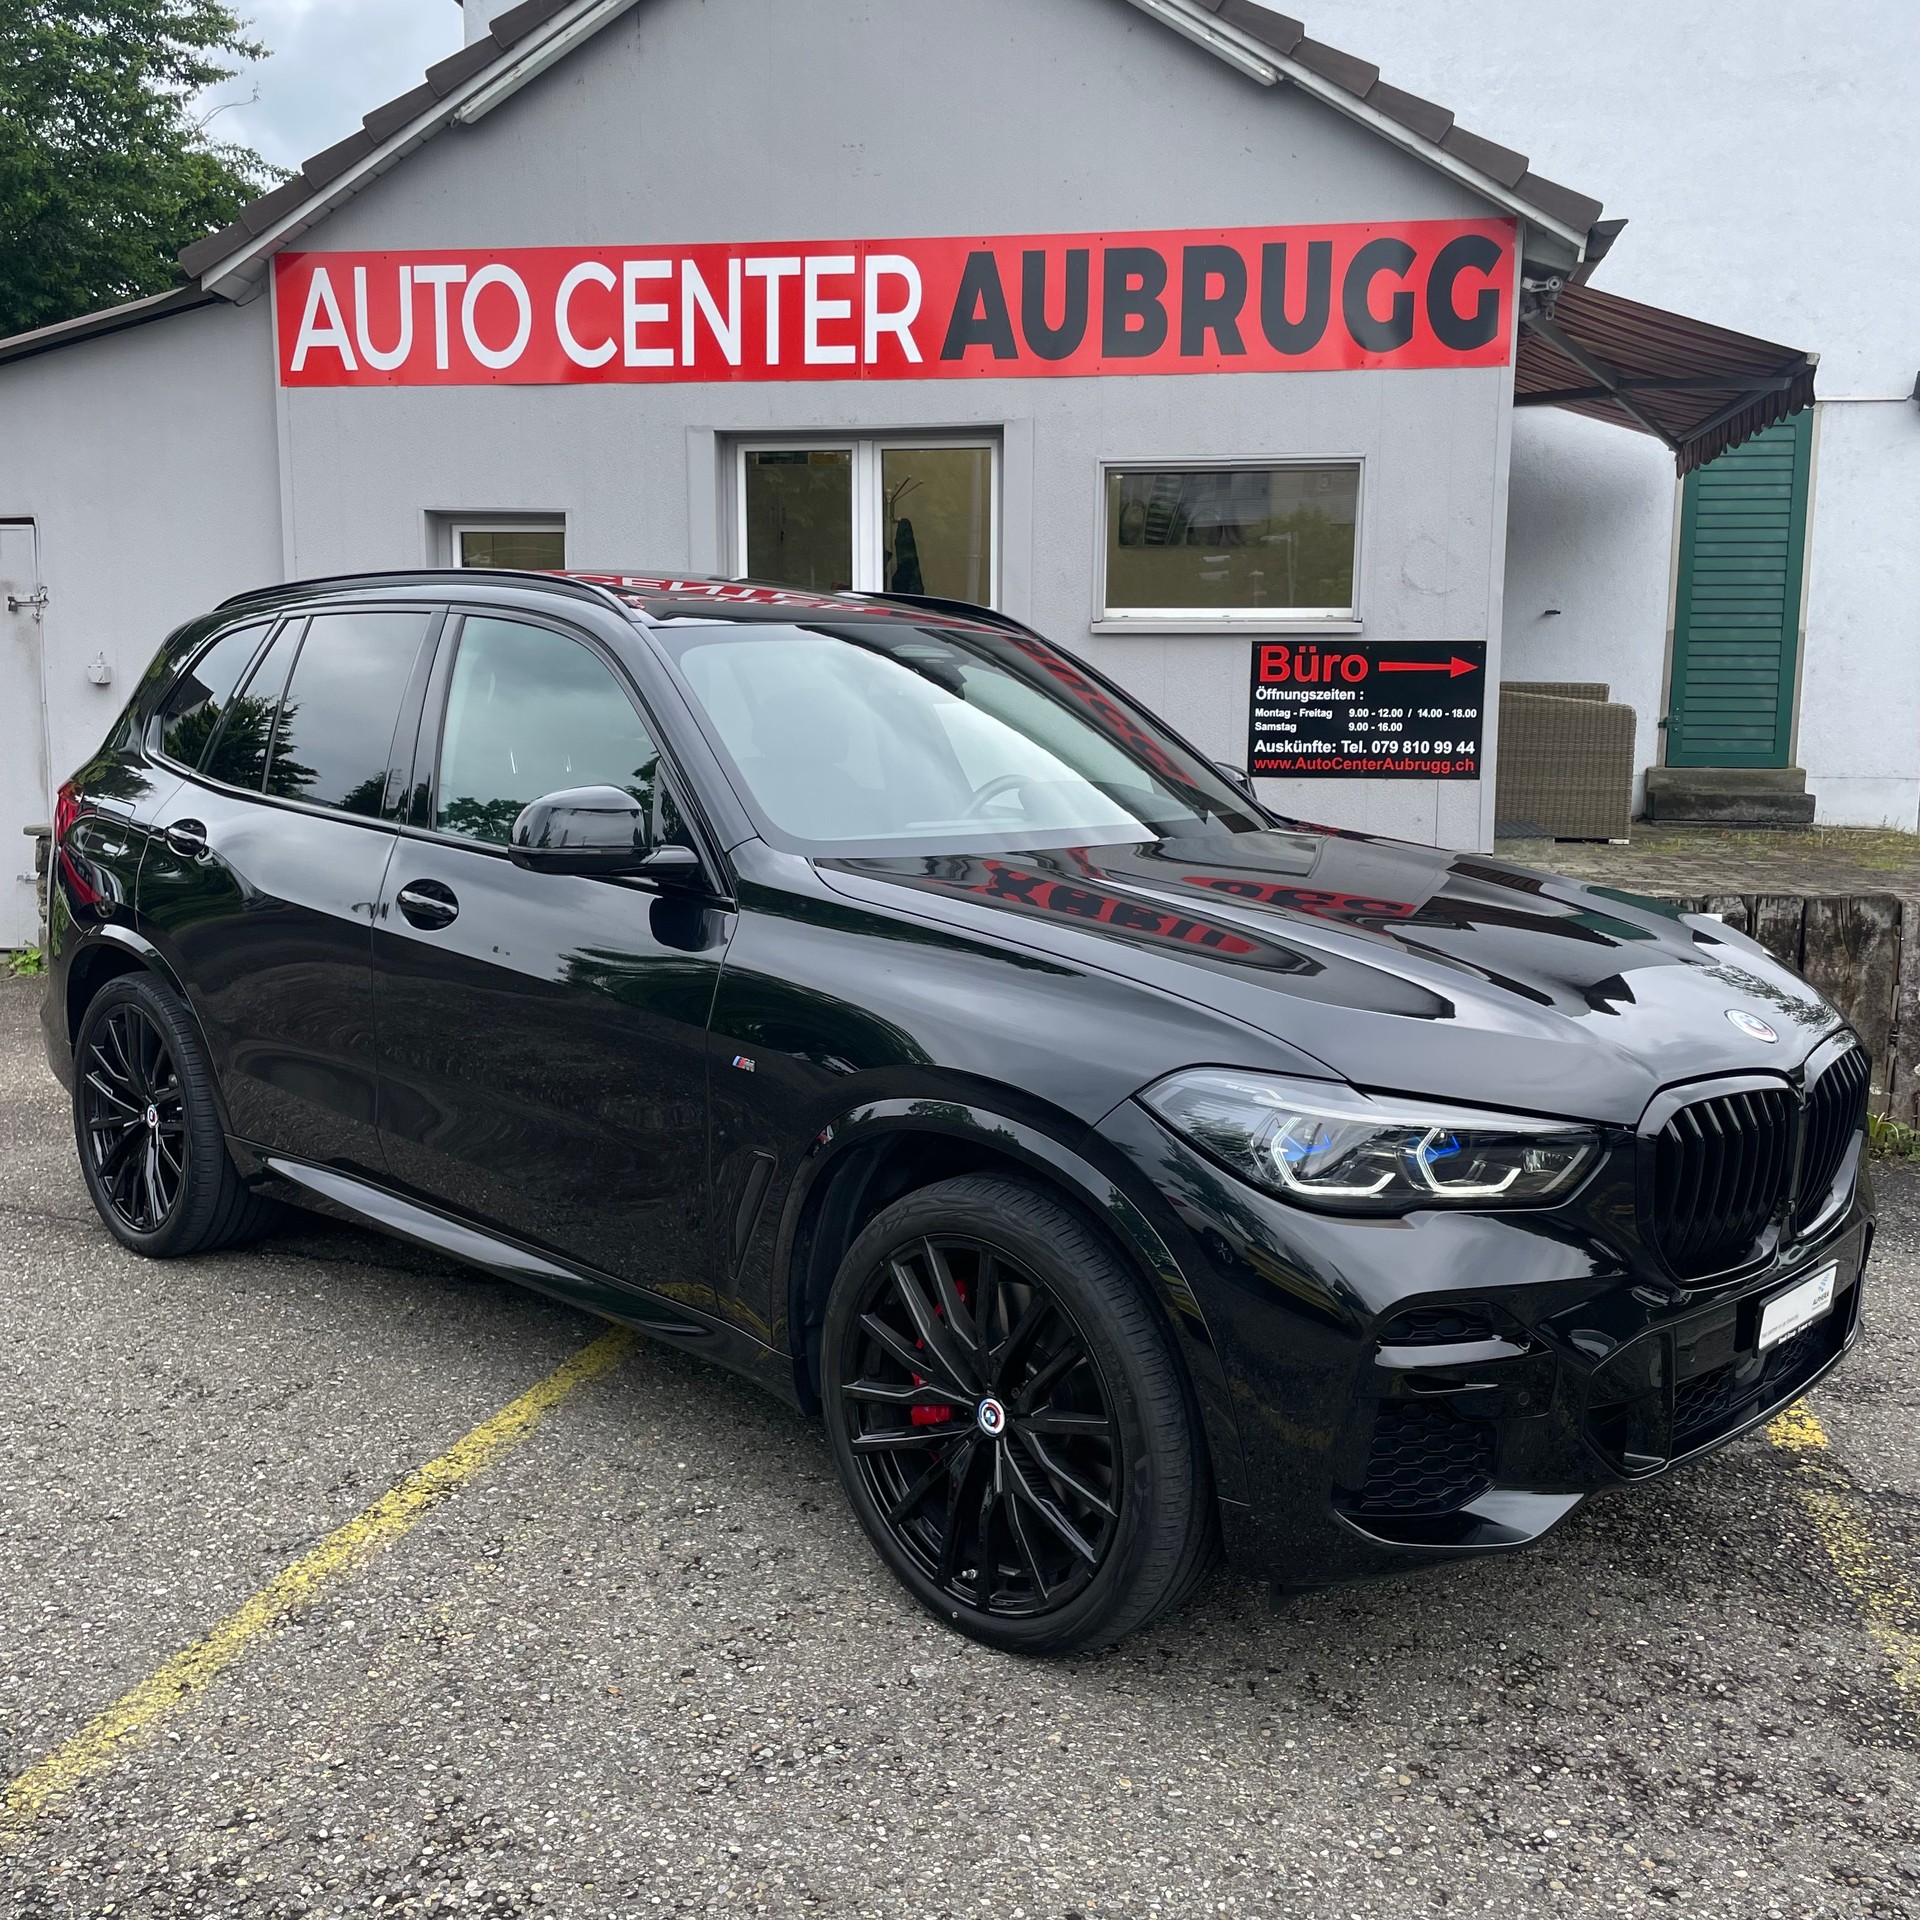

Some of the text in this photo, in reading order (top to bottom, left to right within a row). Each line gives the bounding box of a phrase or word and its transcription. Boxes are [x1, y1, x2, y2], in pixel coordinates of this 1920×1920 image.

[291, 235, 1502, 371] AUTO CENTER AUBRUGG
[1259, 645, 1369, 683] Büro
[1255, 685, 1356, 702] Öffnungszeiten
[1254, 707, 1291, 720] Montag
[1299, 707, 1333, 720] Freitag
[1348, 708, 1370, 718] 9.00
[1377, 708, 1404, 718] 12.00
[1417, 708, 1443, 718] 14.00
[1451, 708, 1478, 719] 18.00
[1254, 721, 1297, 734] Samstag
[1348, 721, 1369, 732] 9.00
[1377, 722, 1403, 732] 16.00
[1253, 739, 1476, 755] Auskünfte: Tel. 079 810 99 44
[1254, 756, 1475, 774] www.AutoCenterAubrugg.ch
